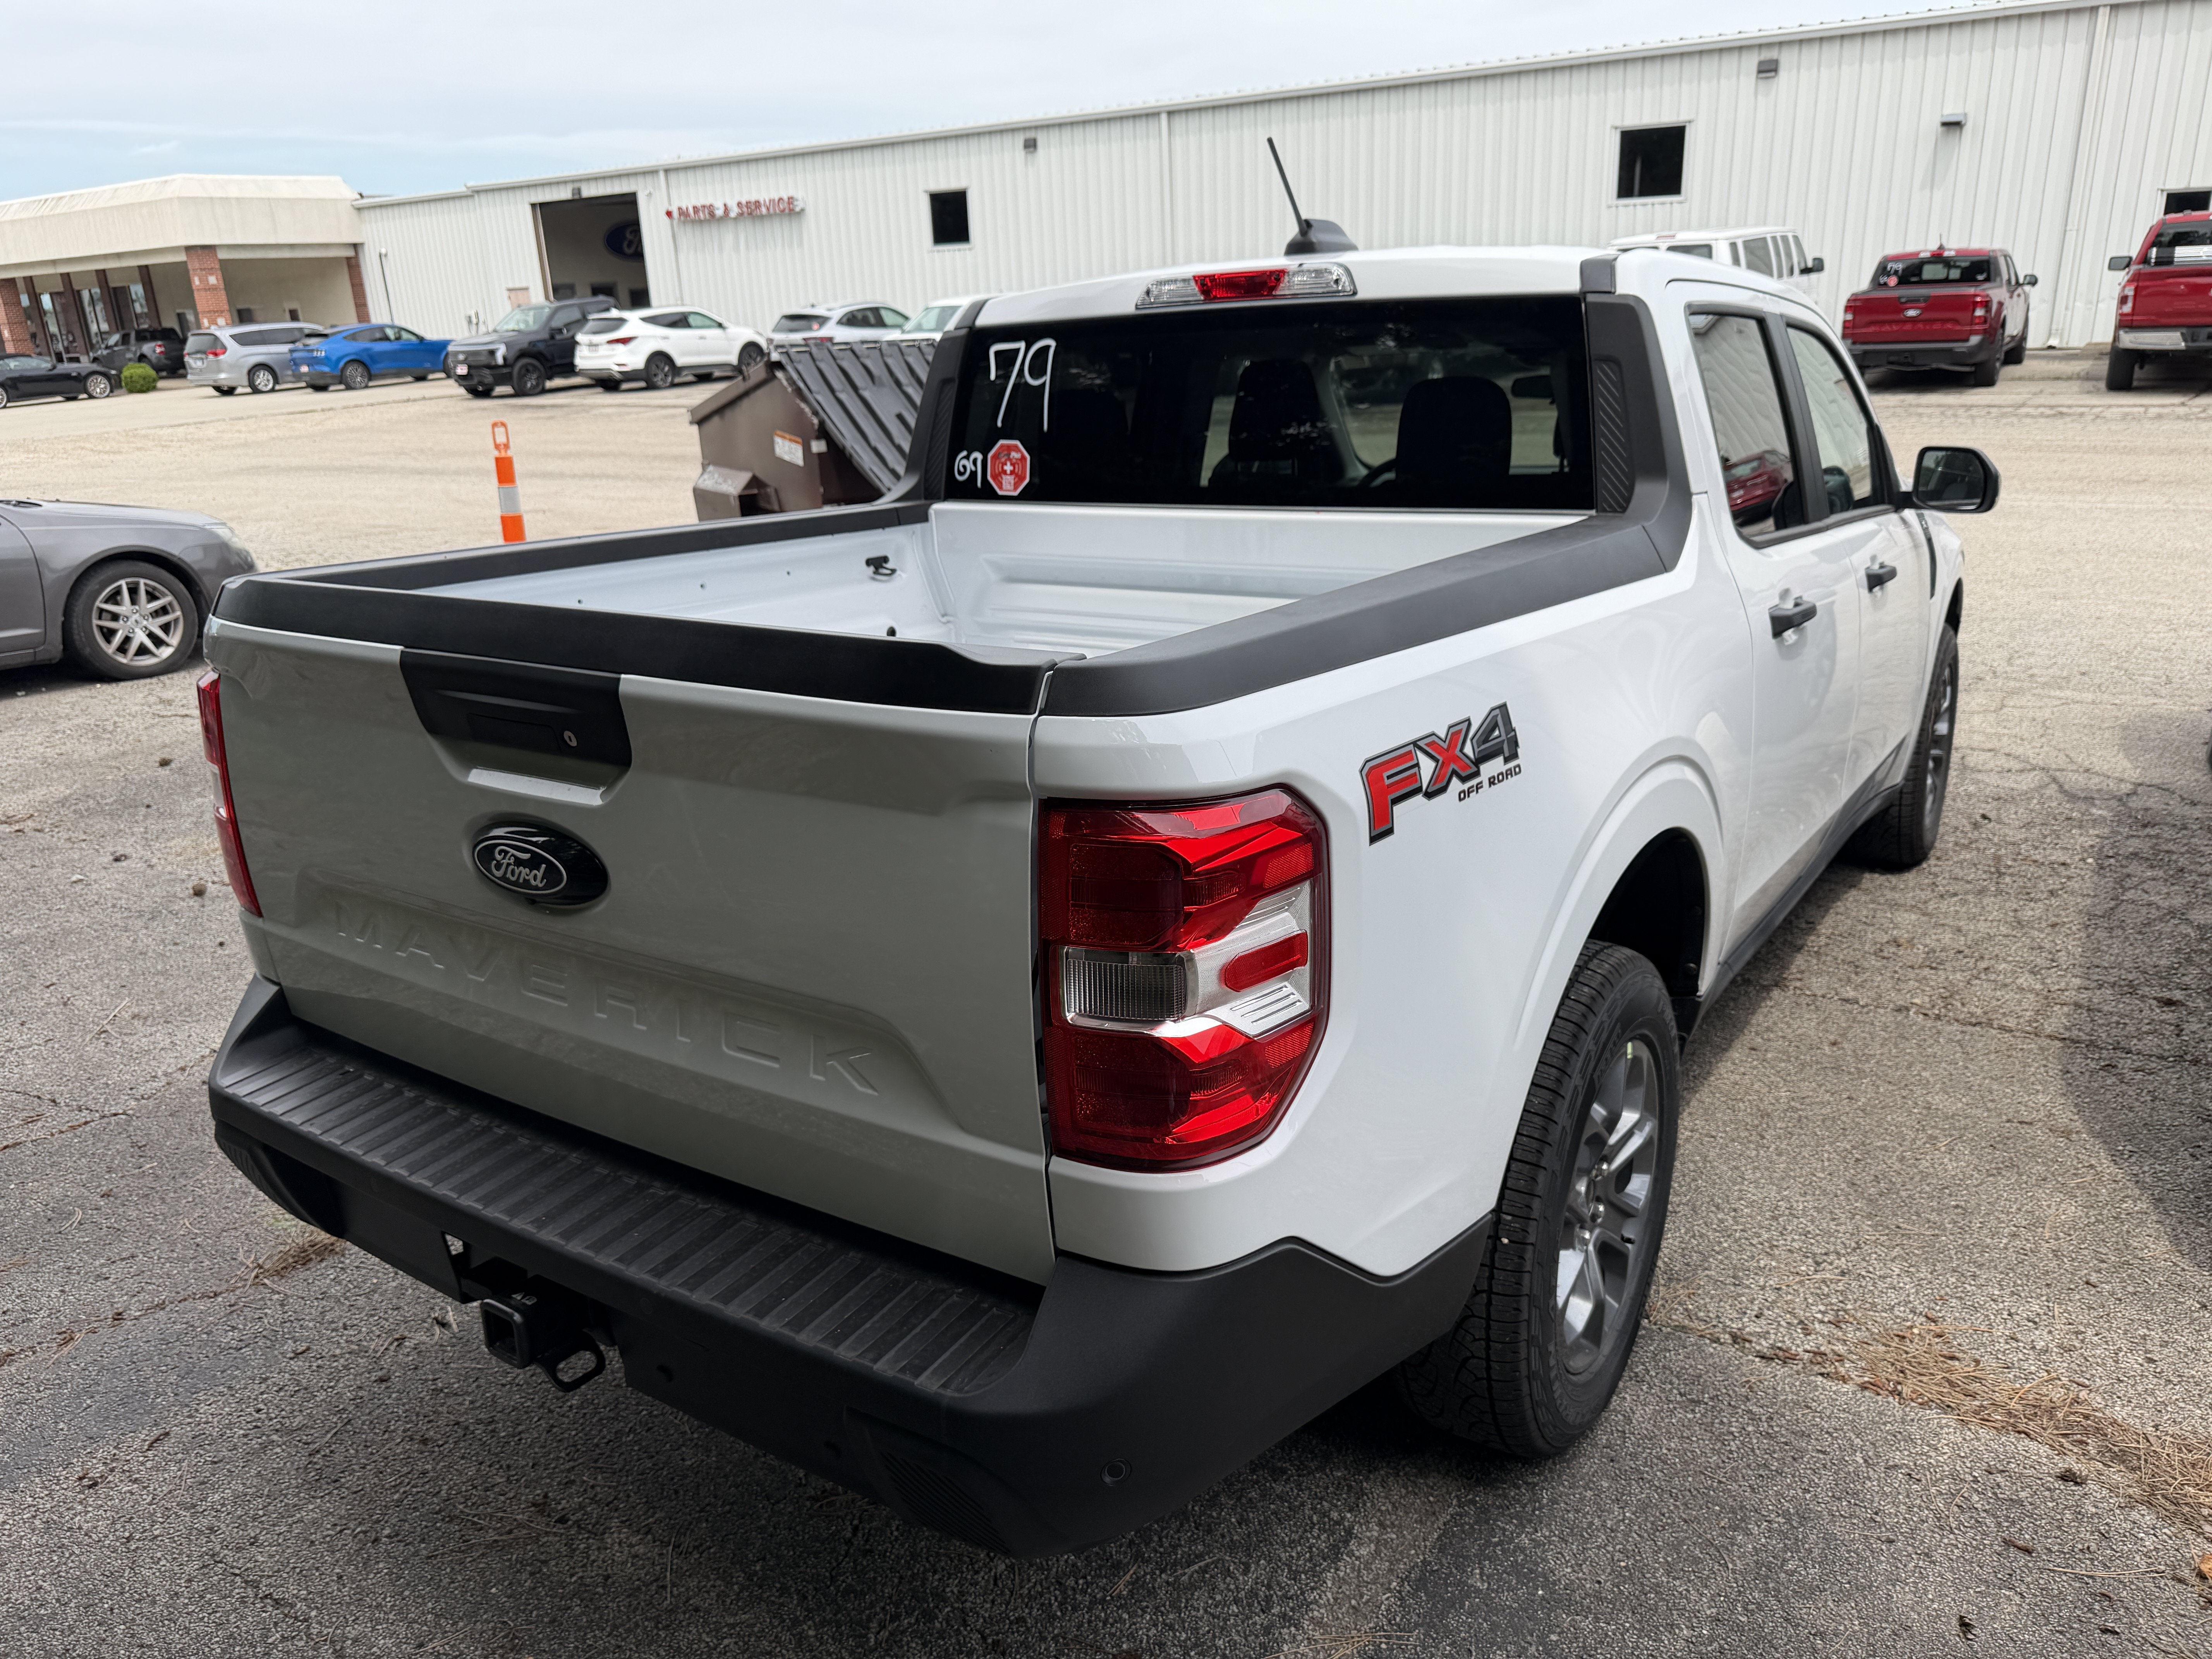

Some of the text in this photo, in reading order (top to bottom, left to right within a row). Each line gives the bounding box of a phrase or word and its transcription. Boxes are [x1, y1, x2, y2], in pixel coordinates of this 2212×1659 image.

[678, 196, 795, 220] PARTS & SERVICE
[989, 338, 1056, 433] 79
[955, 450, 983, 489] 69
[1359, 701, 1520, 846] FX4
[1458, 763, 1522, 802] OFF ROAD
[491, 845, 547, 888] Ford
[336, 901, 879, 1096] MAVERICK
